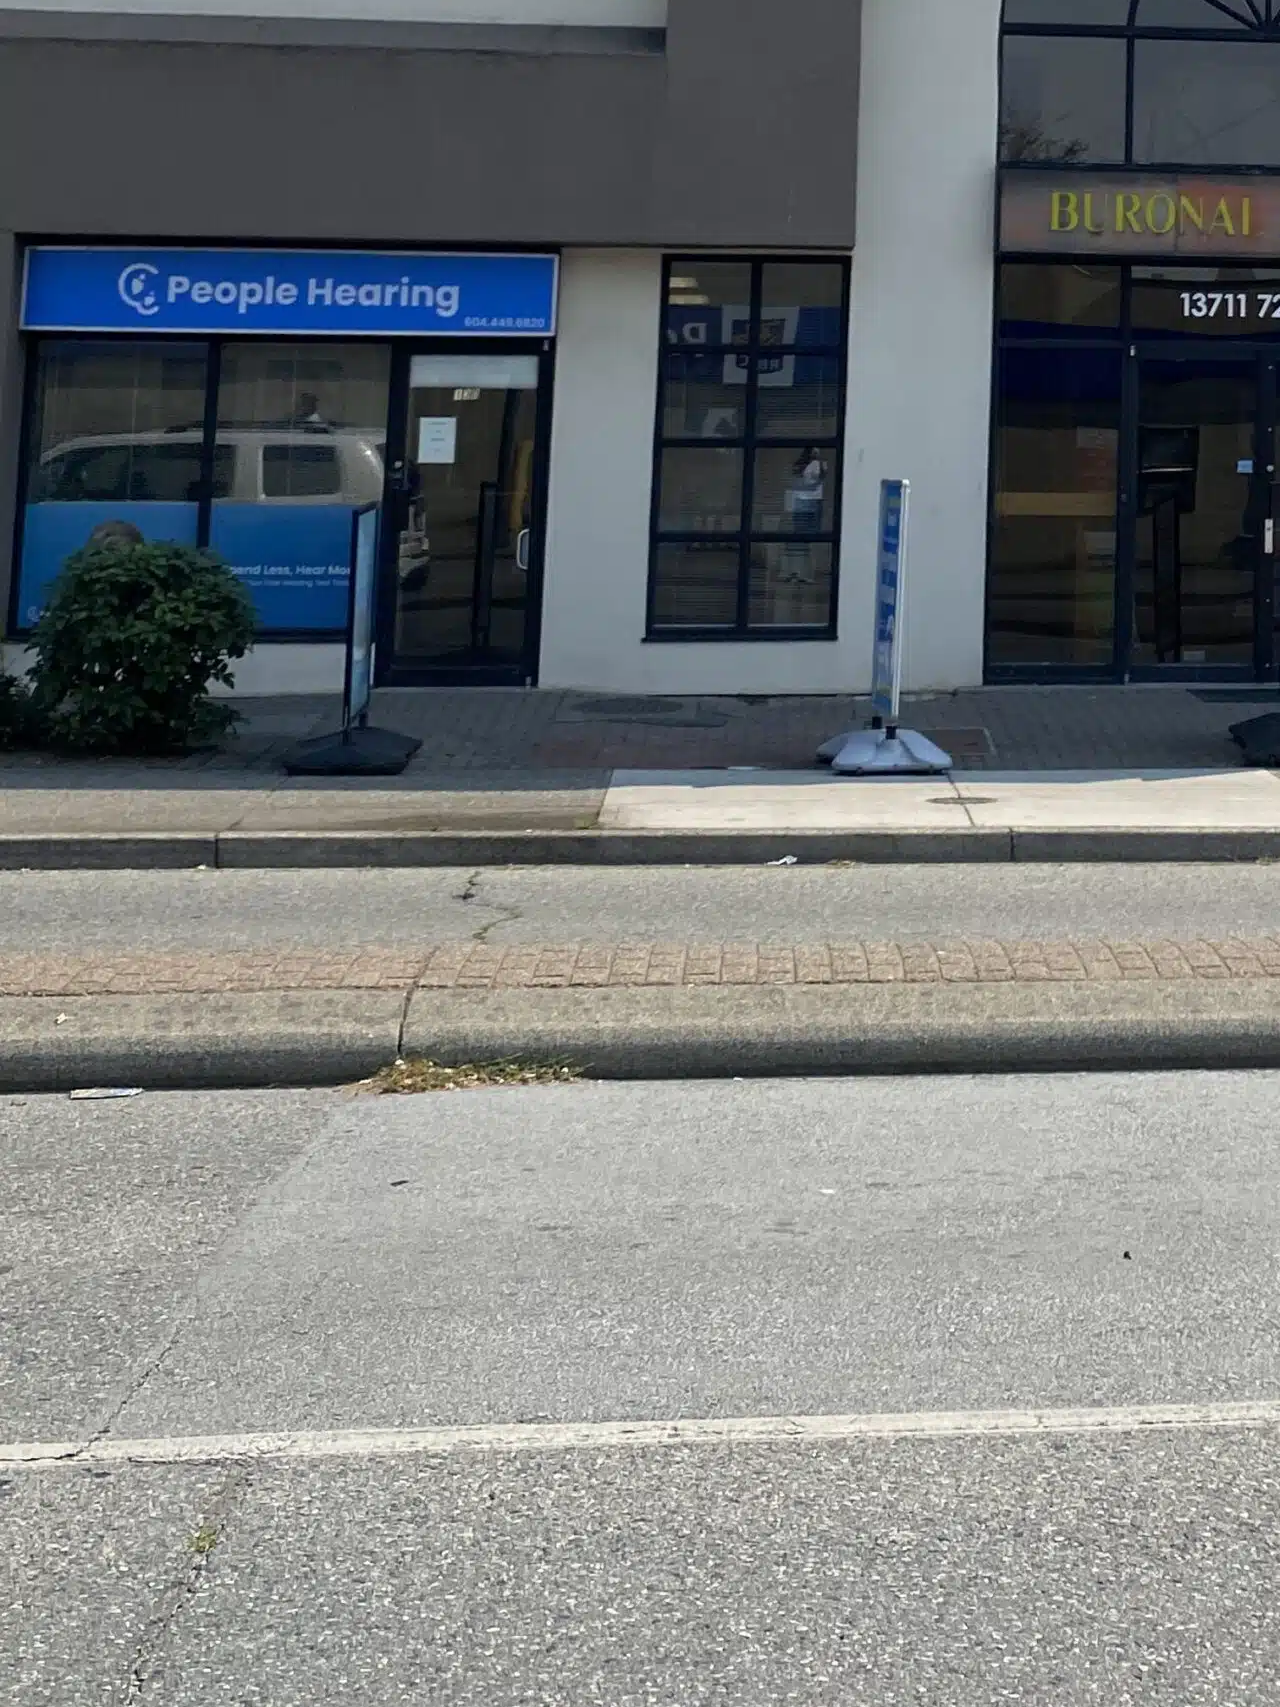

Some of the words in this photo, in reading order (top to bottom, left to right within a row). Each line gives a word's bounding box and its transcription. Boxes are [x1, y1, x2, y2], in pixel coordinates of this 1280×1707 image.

[167, 274, 298, 314] People
[307, 276, 460, 317] Hearing
[1180, 292, 1247, 317] 13711
